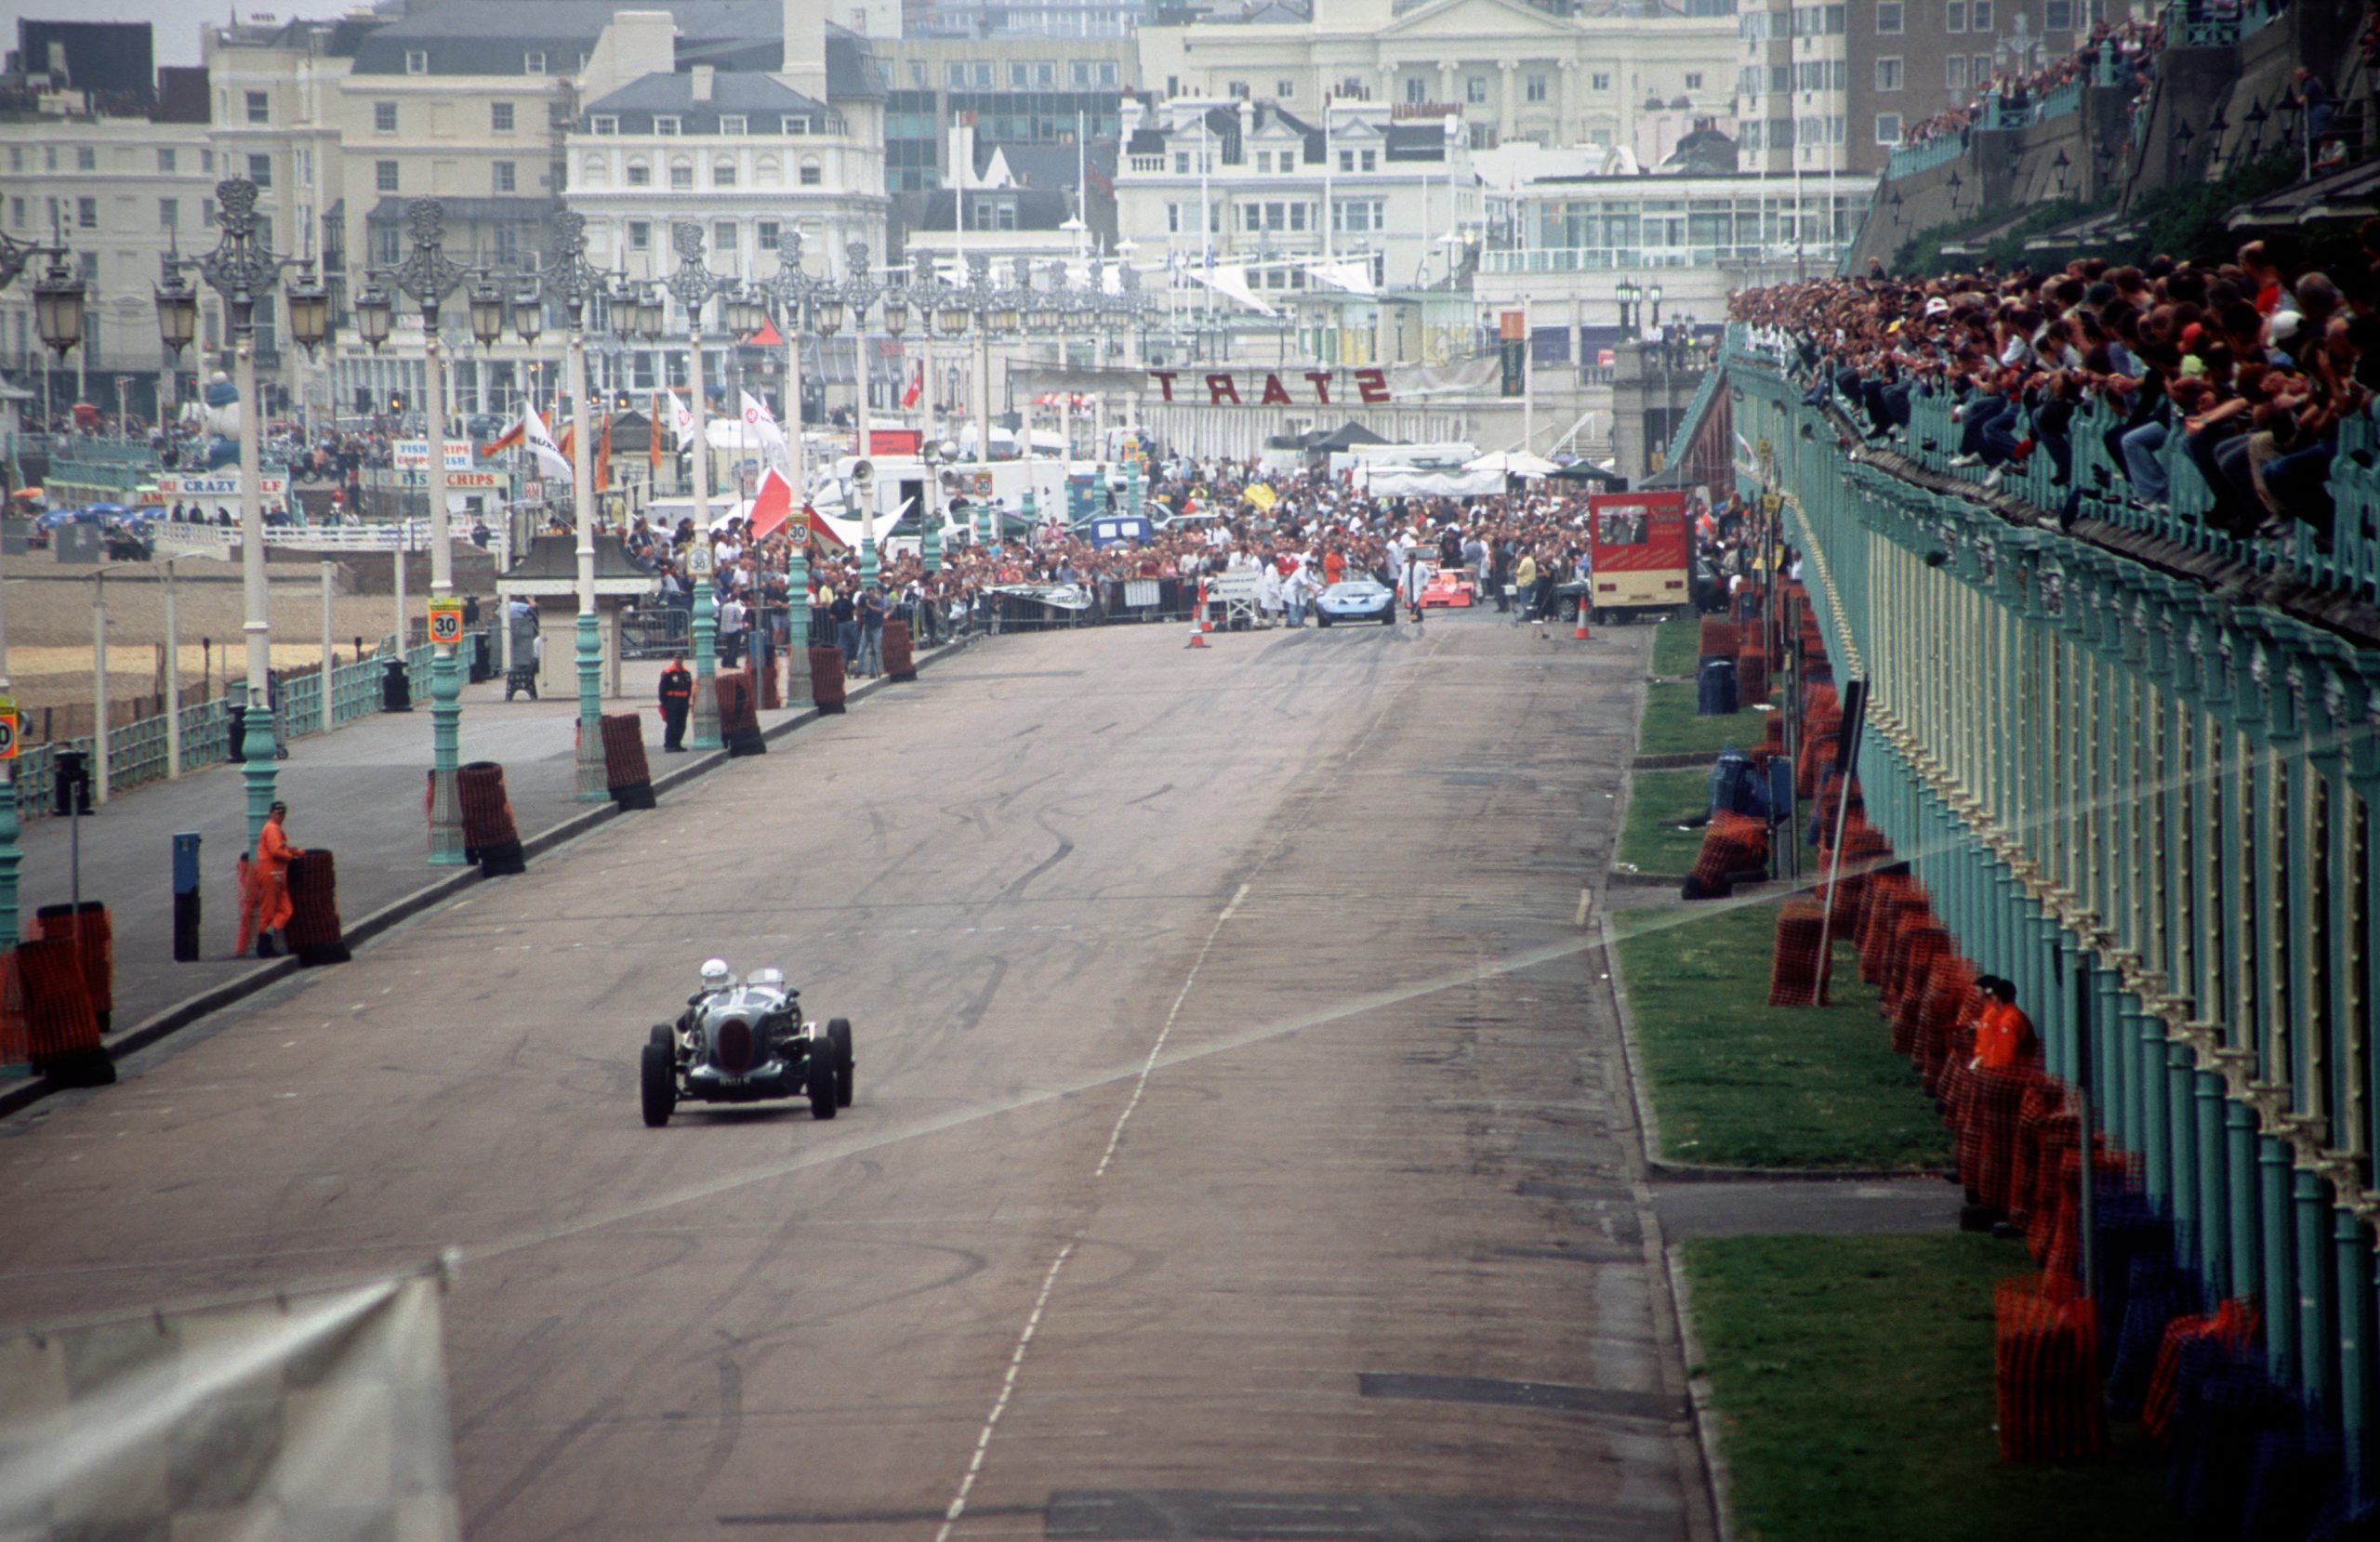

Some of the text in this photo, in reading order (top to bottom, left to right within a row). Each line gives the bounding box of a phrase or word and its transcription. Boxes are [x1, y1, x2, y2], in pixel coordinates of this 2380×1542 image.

[400, 445, 428, 454] FISH
[403, 474, 428, 484] FIS
[447, 474, 494, 485] CHIPS
[184, 481, 236, 492] CRAZY
[977, 483, 990, 492] 30
[790, 526, 805, 538] 30
[435, 618, 456, 632] 30
